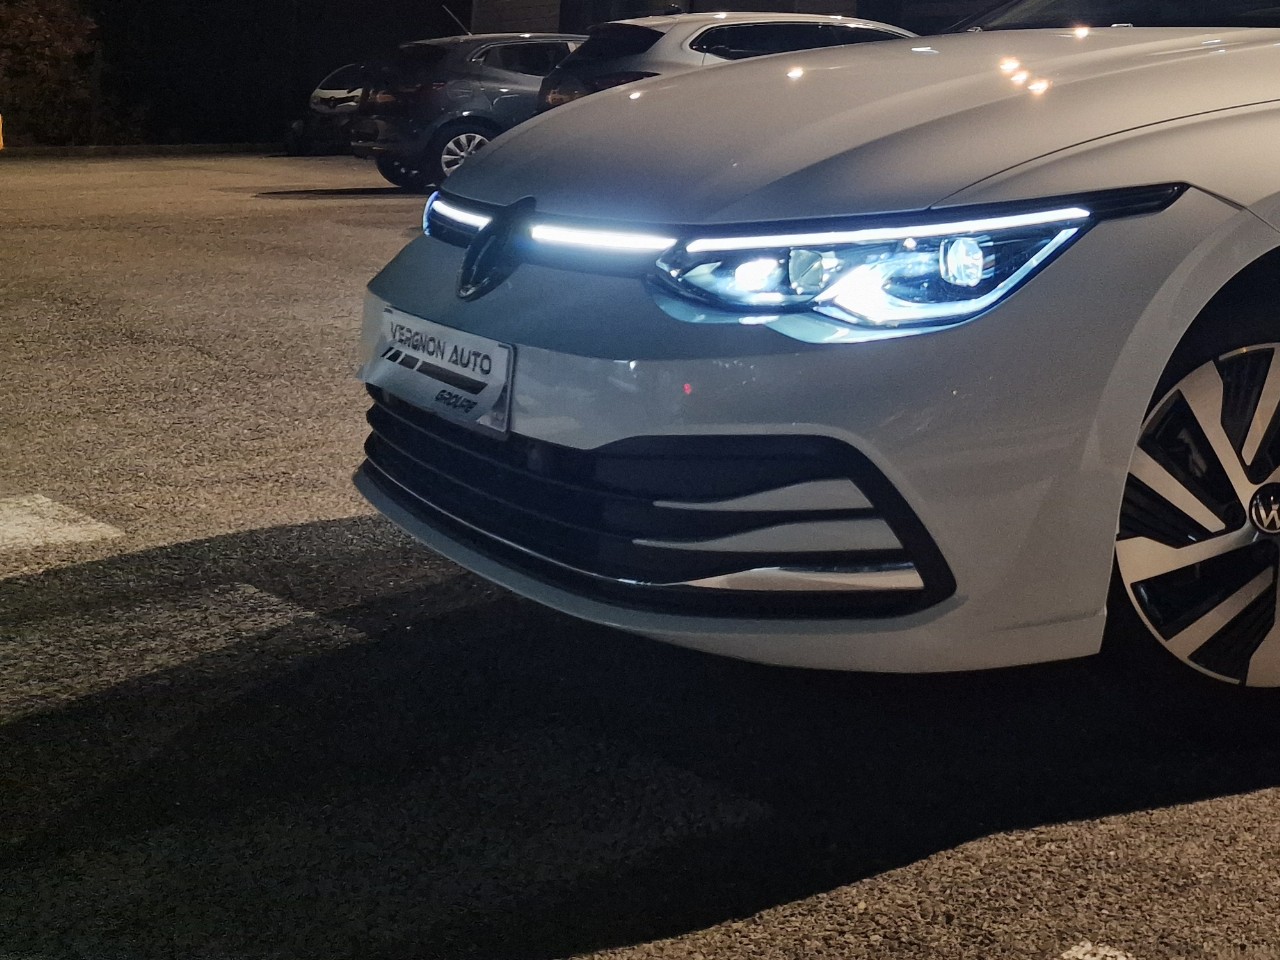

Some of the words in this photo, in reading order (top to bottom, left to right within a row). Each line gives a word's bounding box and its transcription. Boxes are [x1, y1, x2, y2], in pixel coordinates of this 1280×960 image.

[390, 321, 447, 361] VERGNON
[447, 344, 492, 376] AUTO
[435, 389, 478, 414] GROUPE
